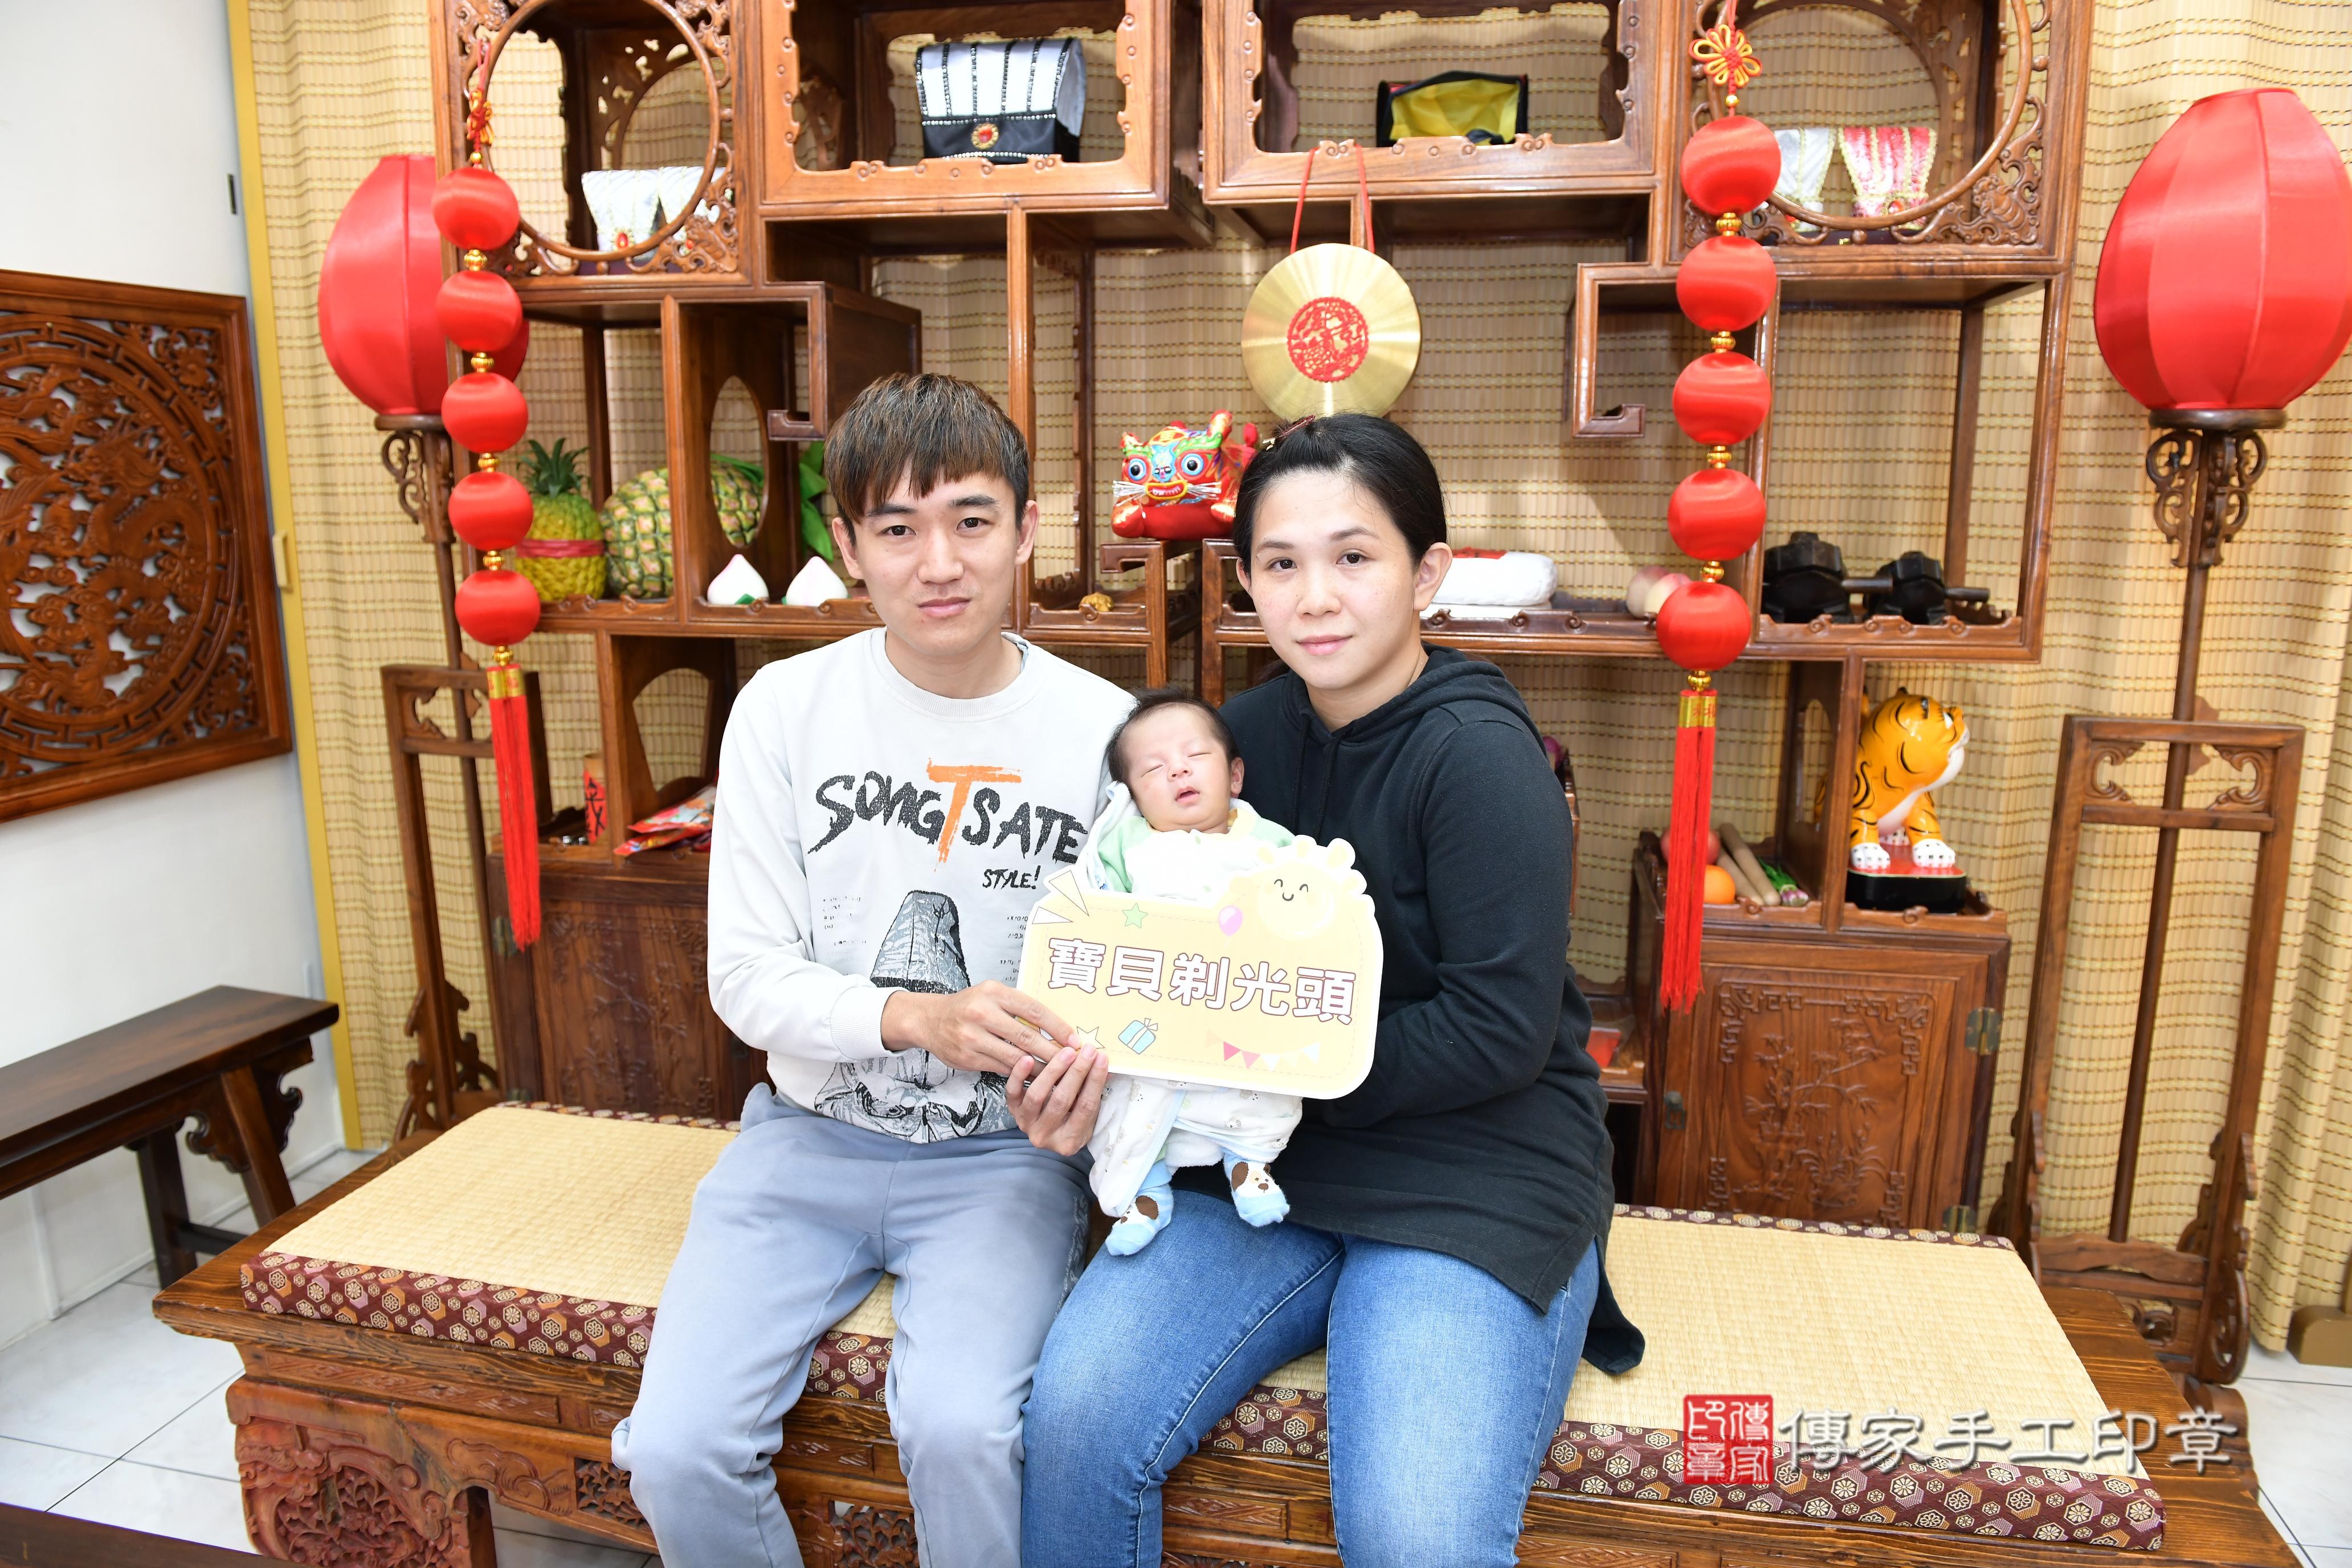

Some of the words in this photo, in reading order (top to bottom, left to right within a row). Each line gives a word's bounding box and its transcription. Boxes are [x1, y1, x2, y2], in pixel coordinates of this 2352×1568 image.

[982, 865, 1041, 889] STYLE!
[1048, 938, 1356, 1025] 寶貝剃光頭
